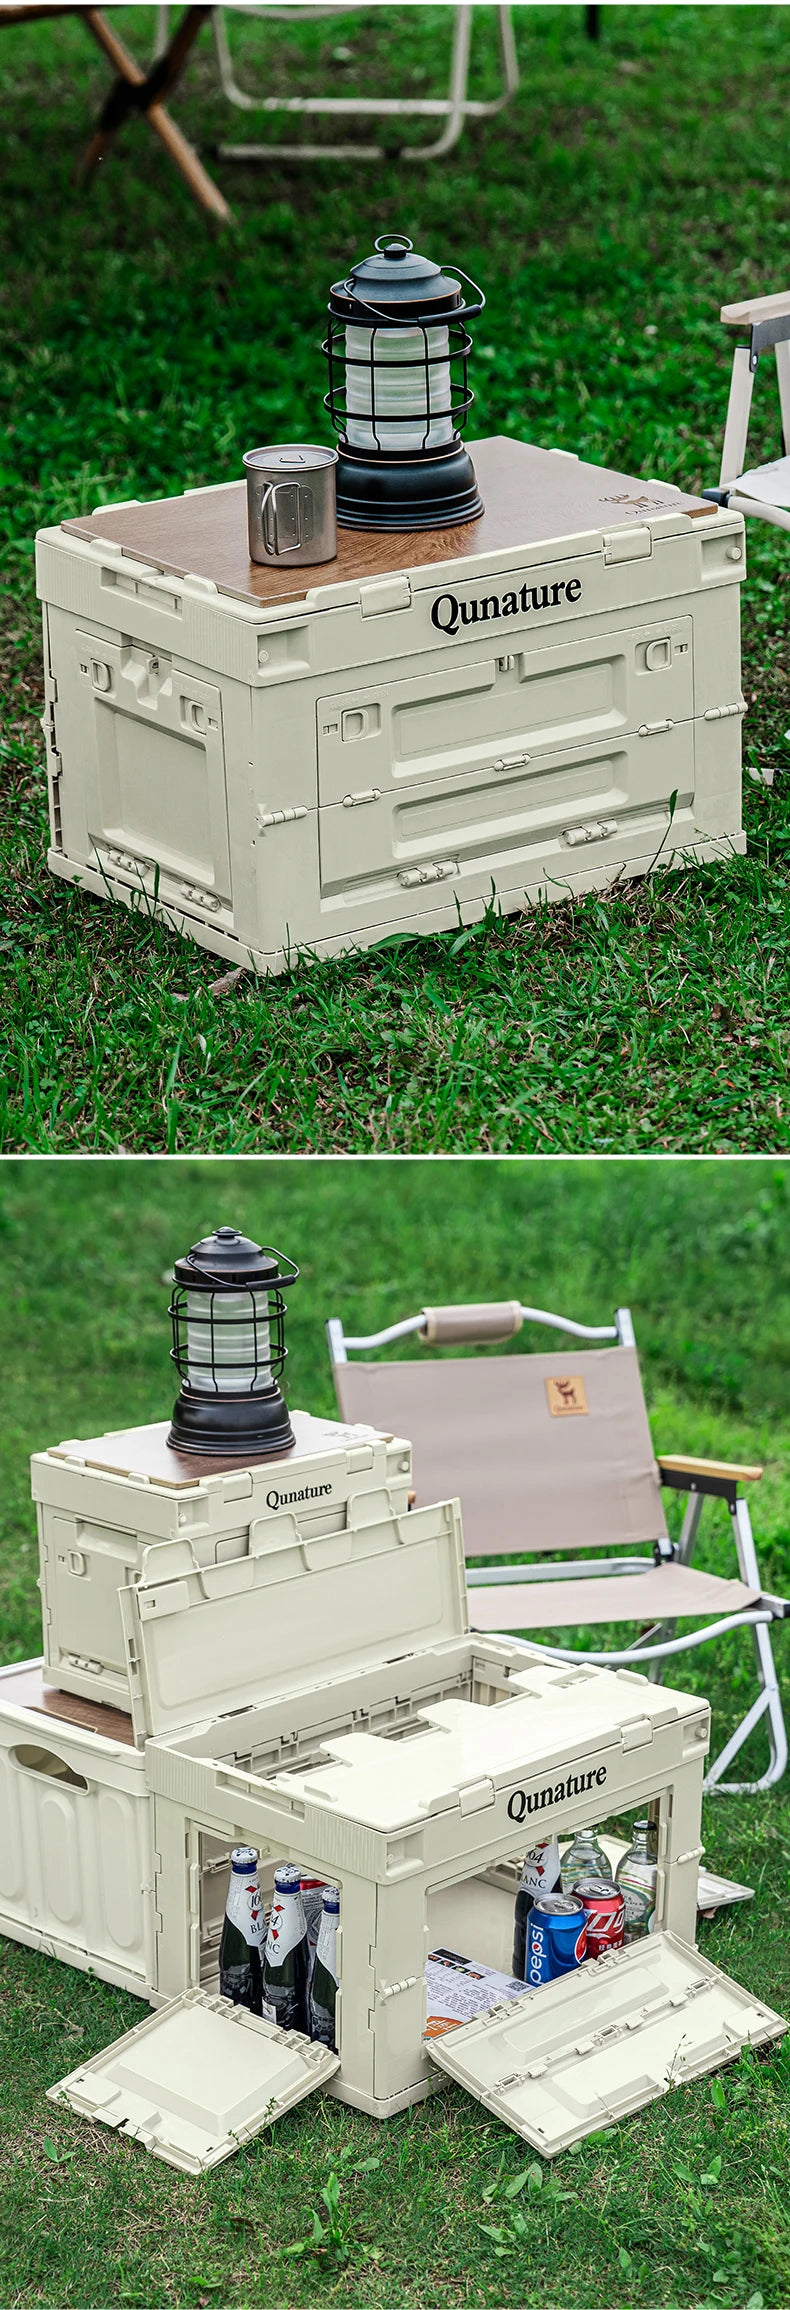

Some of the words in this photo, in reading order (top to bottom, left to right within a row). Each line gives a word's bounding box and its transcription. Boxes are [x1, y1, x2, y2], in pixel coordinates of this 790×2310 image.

[431, 578, 582, 635] Qunature
[266, 1483, 332, 1510] Qunature
[507, 1766, 607, 1823] Qunature
[529, 1922, 547, 1985] pepsi
